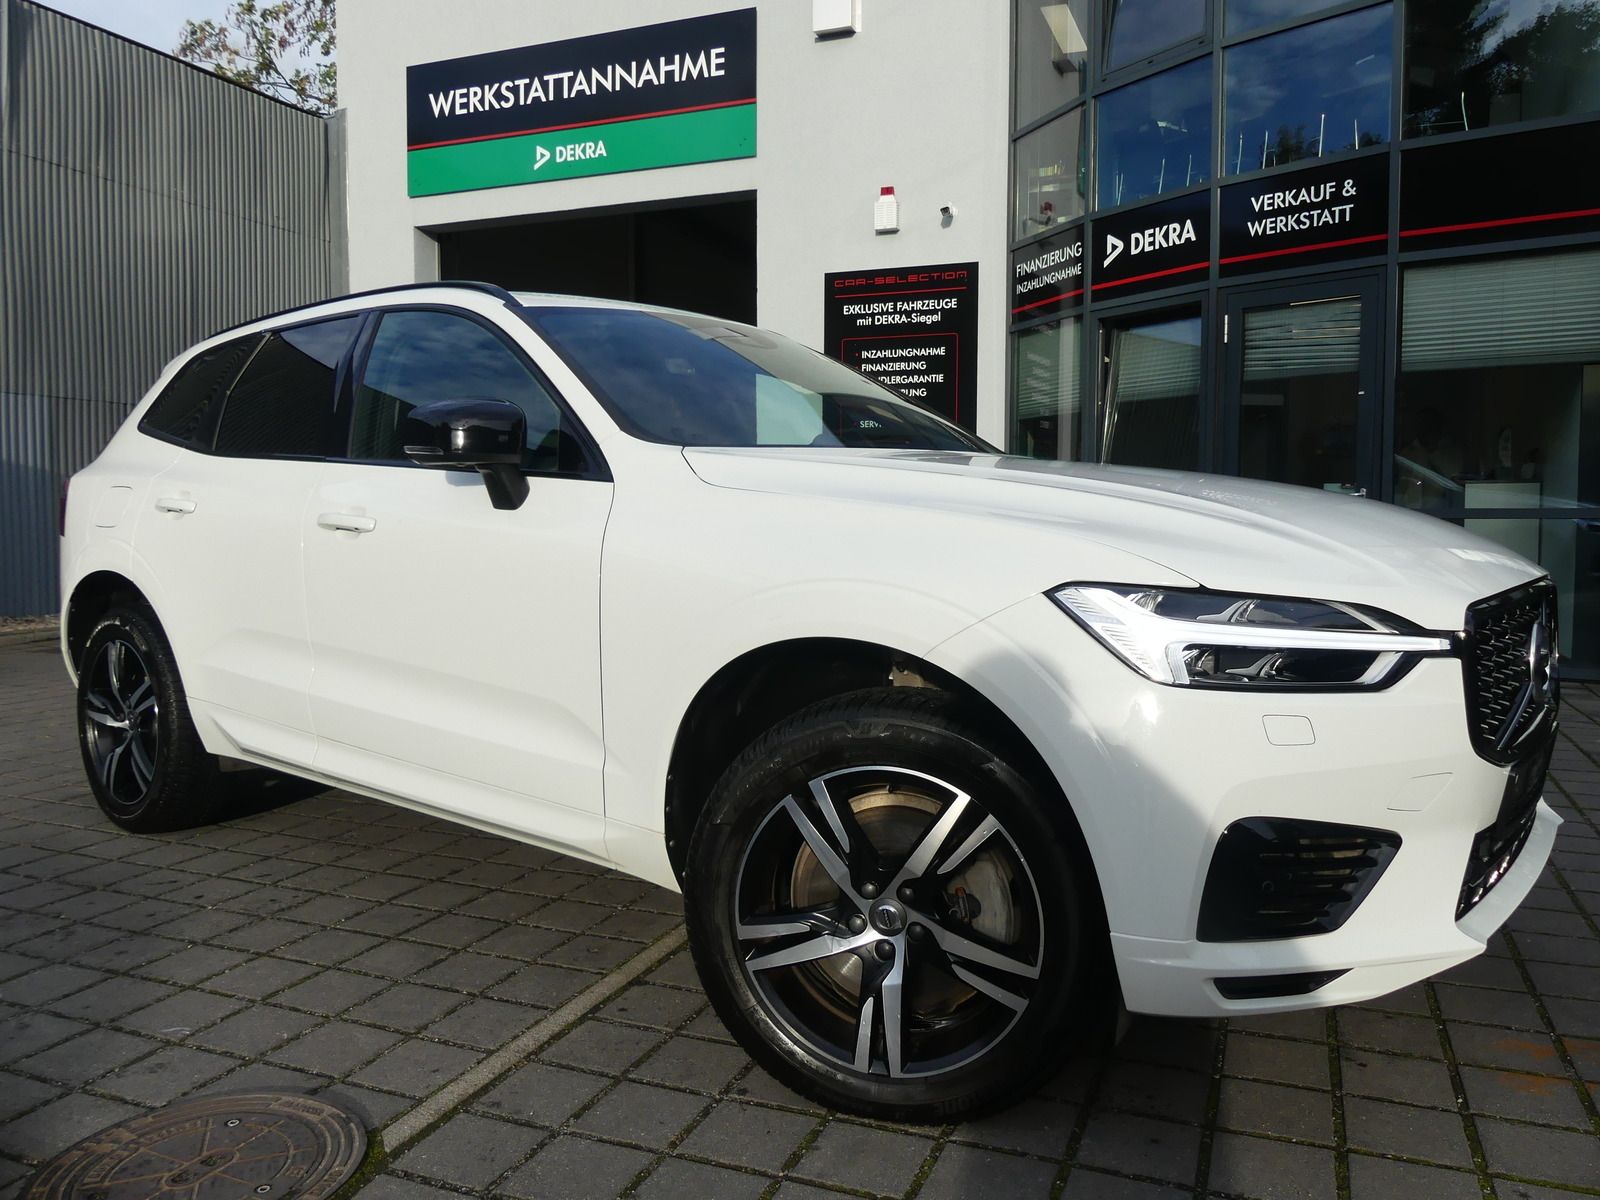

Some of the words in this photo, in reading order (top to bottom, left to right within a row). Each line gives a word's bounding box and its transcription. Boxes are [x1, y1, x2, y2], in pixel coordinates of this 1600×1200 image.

[429, 47, 726, 119] WERKSTATTANNAHME
[555, 140, 607, 163] DEKRA
[1251, 182, 1336, 213] VERKAUF
[1342, 179, 1357, 197] &
[1247, 204, 1354, 238] WERKSTATT
[1130, 219, 1197, 256] DEKRA
[1016, 242, 1083, 278] FINANZIERUNG
[1016, 263, 1082, 295] INZAHLUNGNAHME
[843, 302, 895, 315] EXKLUSIVE
[896, 298, 958, 312] FAHRZEUGE
[856, 316, 873, 326] mit
[874, 311, 941, 326] DEKRA-Siegel
[861, 346, 946, 359] INZAHLUNGNAHME
[861, 361, 927, 372] FINANZIERUNG
[878, 374, 944, 385] DLERGARANTIE
